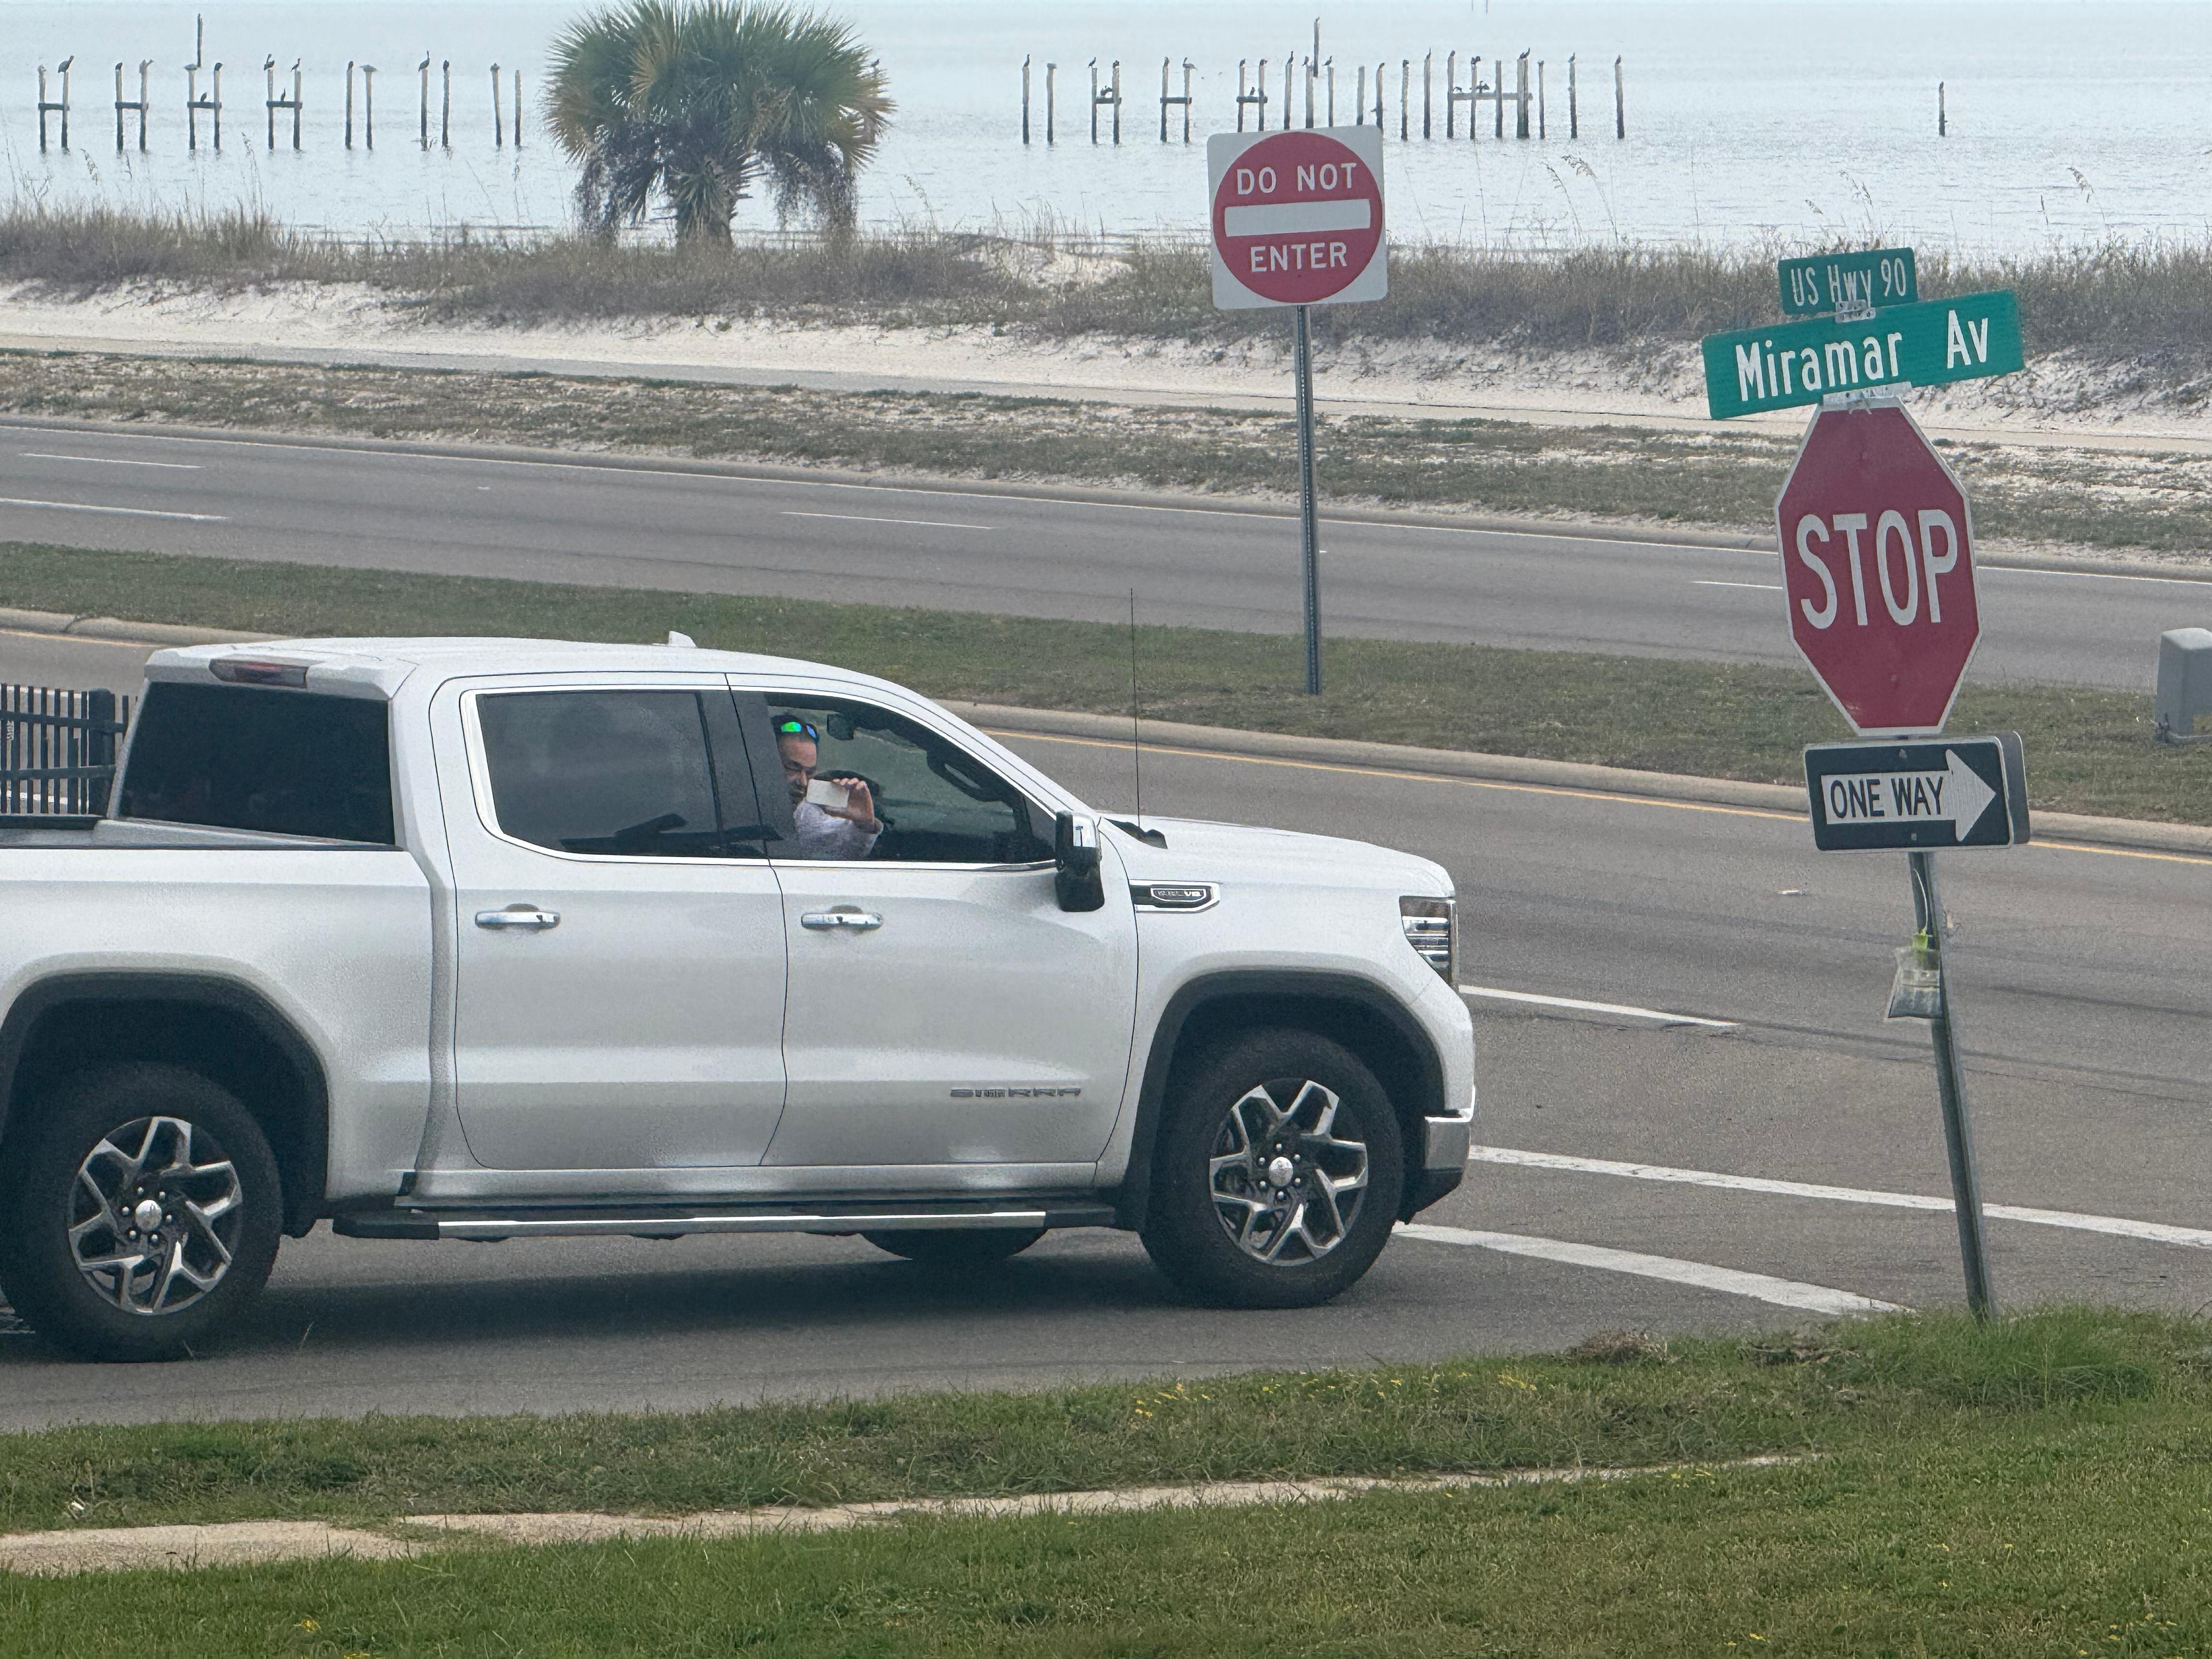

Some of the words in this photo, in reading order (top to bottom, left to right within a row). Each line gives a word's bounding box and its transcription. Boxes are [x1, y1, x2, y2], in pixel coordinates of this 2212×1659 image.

[1236, 167, 1277, 195] DO
[1297, 162, 1357, 192] NOT
[1250, 241, 1348, 273] ENTER
[1791, 266, 1819, 307] US
[1827, 264, 1871, 308] Hwy
[1881, 257, 1906, 297] 90
[1735, 331, 1903, 402] Miramar
[1947, 309, 1988, 369] Av
[1796, 509, 1959, 629] STOP
[1830, 777, 1885, 819] ONE
[1890, 775, 1944, 817] WAY
